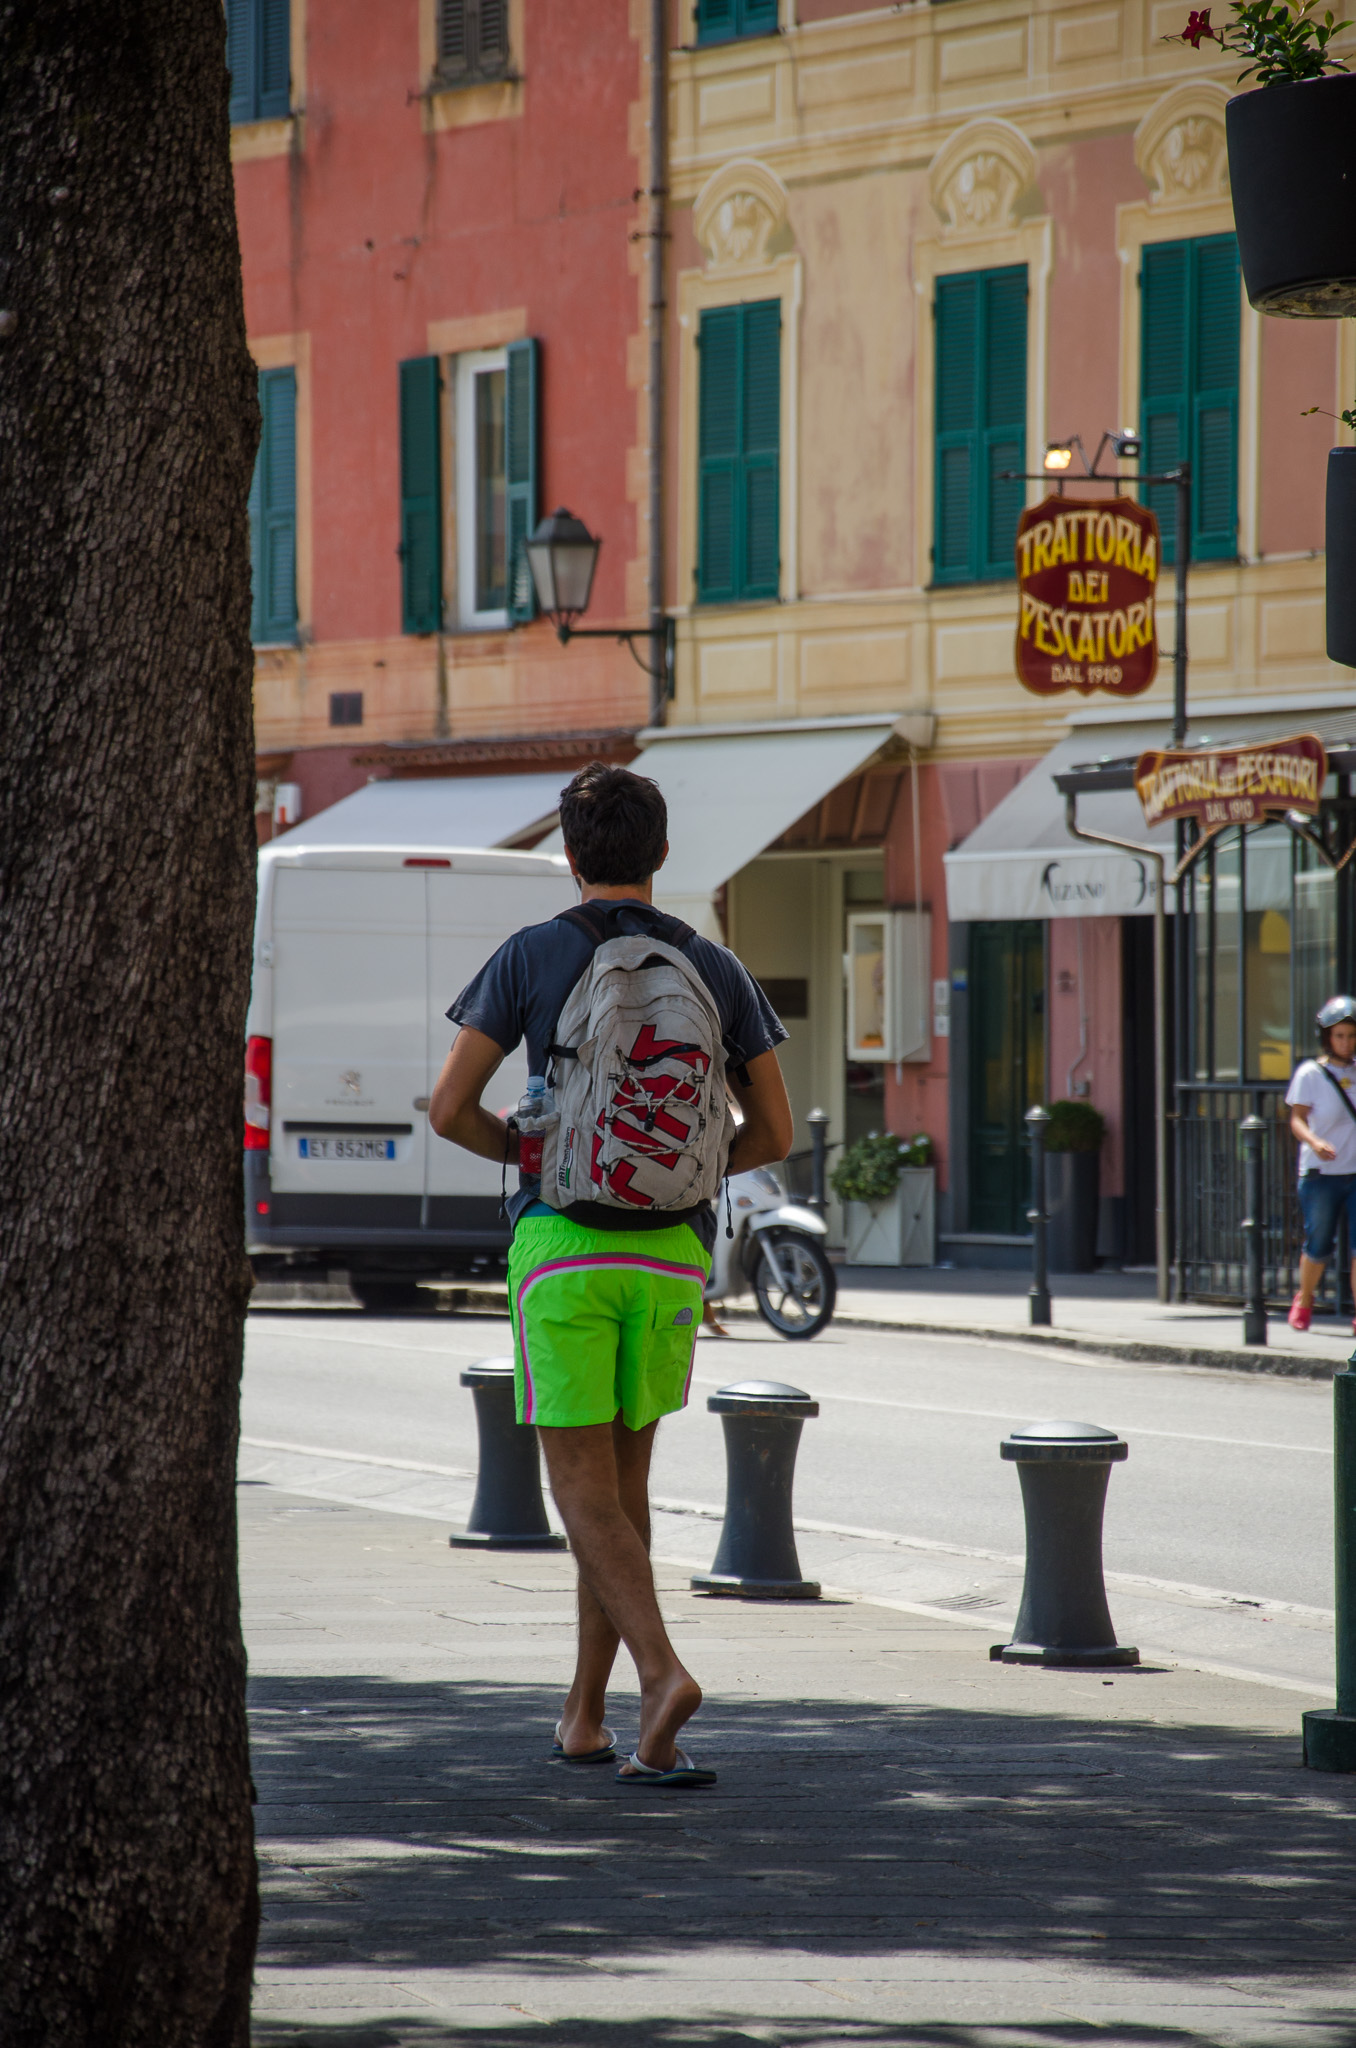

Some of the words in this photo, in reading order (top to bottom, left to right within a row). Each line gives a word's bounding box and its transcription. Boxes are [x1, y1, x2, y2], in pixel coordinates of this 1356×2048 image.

[1018, 510, 1157, 582] TRATTORIA
[1068, 570, 1109, 603] DEI
[1021, 591, 1154, 662] PESCATORI
[1051, 664, 1084, 683] DAL
[1087, 664, 1123, 684] 1910
[1237, 752, 1318, 800] PESCATORI
[1205, 801, 1228, 822] DAL
[1229, 798, 1255, 820] 1910
[309, 1138, 328, 1158] EY
[335, 1139, 385, 1159] 852MG
